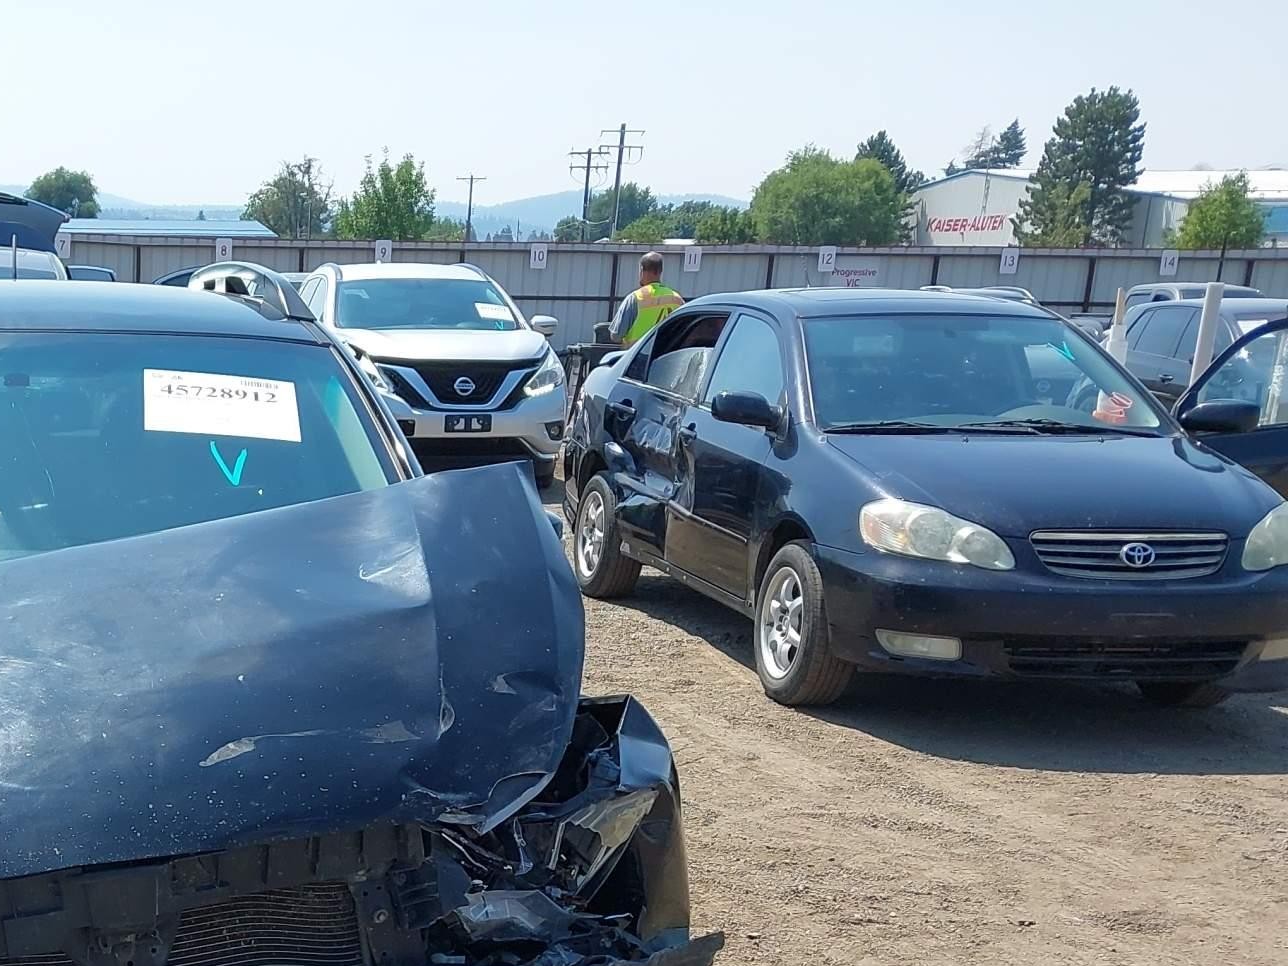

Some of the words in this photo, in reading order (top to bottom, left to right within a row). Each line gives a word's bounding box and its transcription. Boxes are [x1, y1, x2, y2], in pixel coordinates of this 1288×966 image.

[925, 214, 1006, 233] KAISER-ALUTEK
[533, 250, 545, 262] 10
[688, 254, 697, 265] 11
[821, 253, 833, 265] 12
[1004, 256, 1015, 267] 13
[1164, 256, 1175, 268] 14
[845, 278, 861, 287] VIC
[160, 383, 278, 403] 45728912
